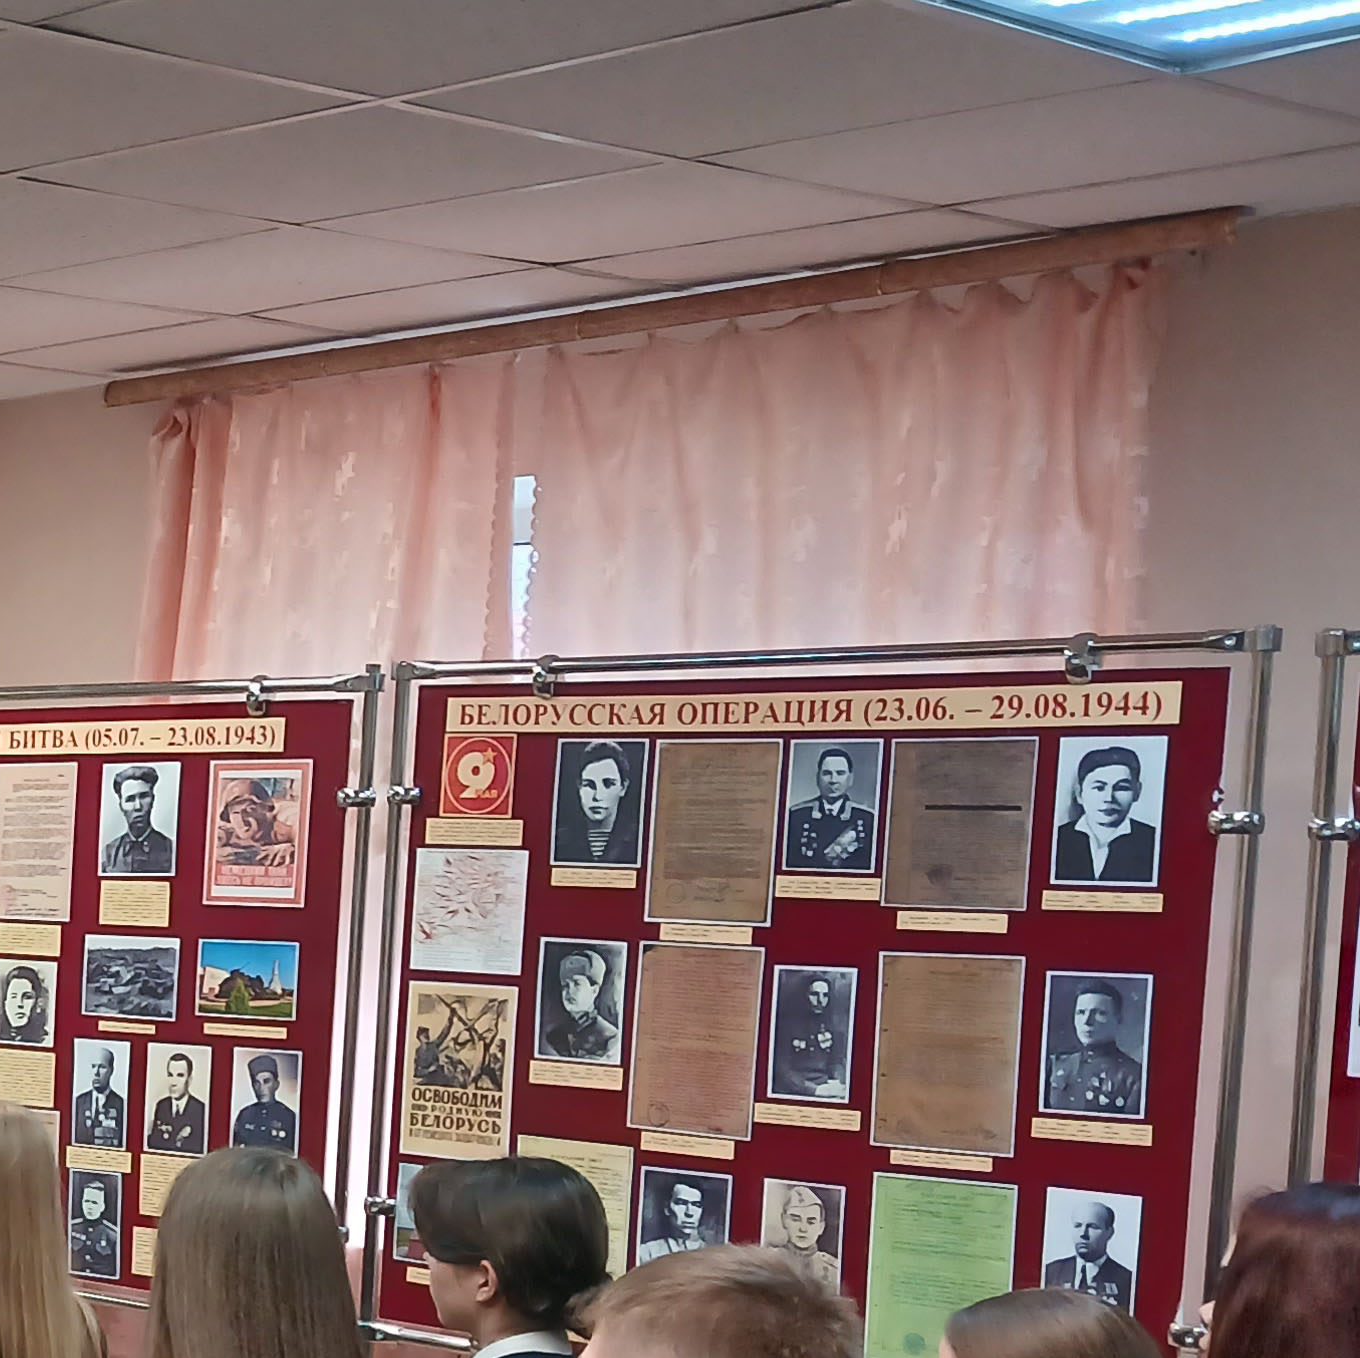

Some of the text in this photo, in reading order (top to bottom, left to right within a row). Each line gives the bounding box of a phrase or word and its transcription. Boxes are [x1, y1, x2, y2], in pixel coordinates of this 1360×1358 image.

[459, 703, 667, 726] БЕЛОРУССКАЯ
[677, 698, 853, 726] ОПЕРАЦИЯ
[863, 697, 955, 728] (23.06.
[990, 690, 1163, 721] 29.08.1944)
[8, 729, 78, 750] БИТВА
[84, 728, 144, 751] (05.07.
[167, 725, 276, 748] 23.08.1943)
[411, 1087, 502, 1109] ОСВОБОДИМ
[409, 1112, 501, 1134] БЕЛОРУСЬ
